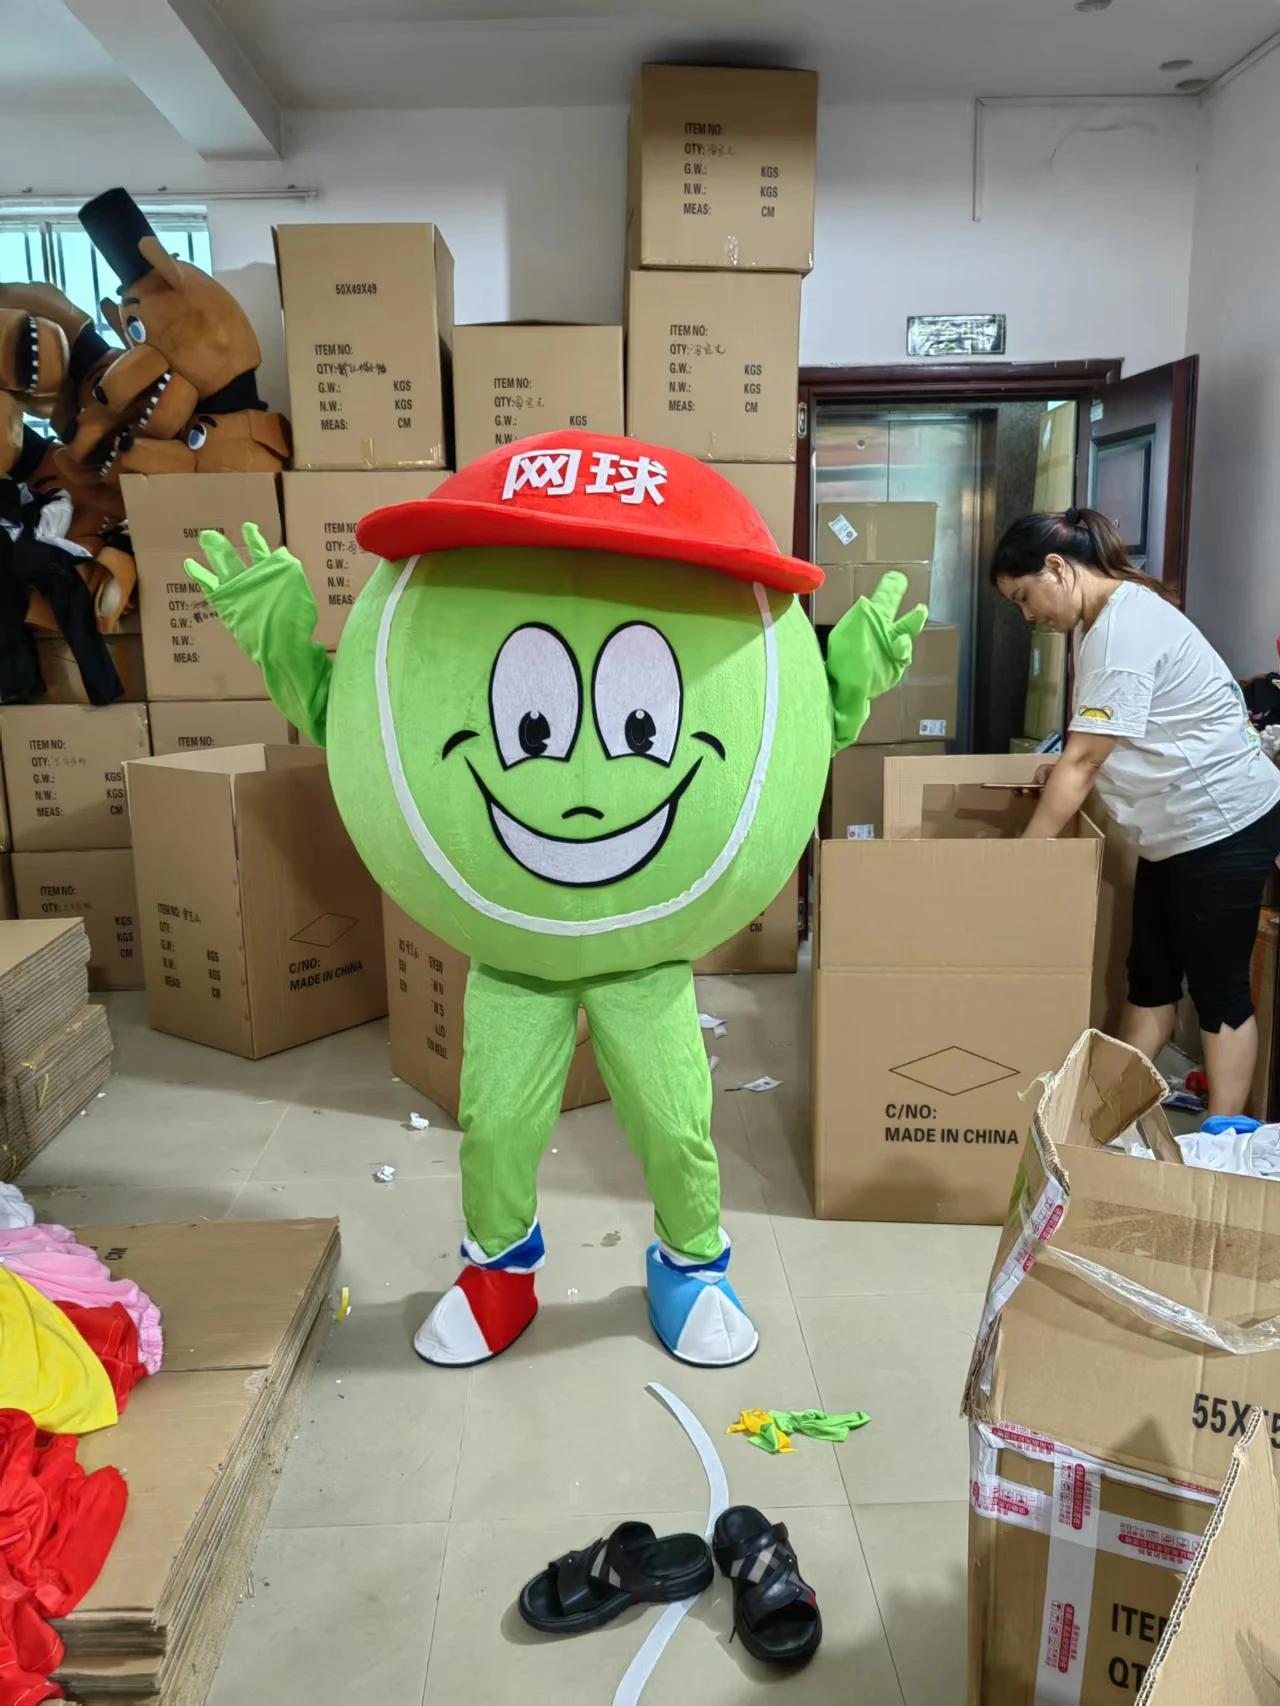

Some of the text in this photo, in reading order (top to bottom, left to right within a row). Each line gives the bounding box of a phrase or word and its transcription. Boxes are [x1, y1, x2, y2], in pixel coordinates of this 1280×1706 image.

[685, 122, 706, 135] ITEM
[684, 143, 705, 156] QTY:
[760, 166, 779, 178] KGS
[760, 186, 778, 198] KGS
[683, 203, 775, 217] MEAS: CM
[335, 283, 377, 295] 50X49X49
[670, 324, 708, 337] ITEM NO:
[315, 344, 354, 356] ITEM NO:
[670, 343, 690, 355] QTY:
[317, 364, 337, 375] QTY:
[669, 362, 762, 376] G.W.: KGS
[318, 380, 411, 393] G.W.: KGS
[494, 377, 532, 389] ITEM NO:
[669, 381, 761, 394] N.W.: KGS
[320, 399, 413, 412] N.W.: KGS
[494, 396, 515, 408] QTY:
[668, 400, 758, 413] MEAS: CM
[321, 417, 411, 430] MEAS: CM
[495, 415, 587, 426] G.W.: KGS
[502, 448, 668, 505] 网球
[324, 522, 345, 533] ITEM
[325, 540, 345, 552] QTY:
[326, 558, 349, 569] G.W.:
[167, 582, 187, 594] ITEM
[327, 577, 350, 587] N.W.:
[168, 601, 188, 611] QTY:
[173, 653, 200, 663] MEAS:
[29, 739, 66, 750] ITEM NO:
[178, 736, 215, 747] ITEM NO:
[31, 756, 51, 767] QTY:
[105, 771, 122, 782] KGS
[106, 788, 124, 799] KGS
[37, 805, 123, 817] MEAS: CM
[40, 885, 76, 897] ITEM NO:
[115, 916, 133, 926] KGS
[750, 922, 763, 933] CM
[117, 932, 134, 942] KGS
[120, 948, 133, 959] CM
[288, 957, 321, 975] C/NO:
[290, 959, 363, 992] MADE IN CHINA
[211, 987, 221, 999] CM
[885, 1104, 938, 1120] C/NO:
[884, 1127, 1019, 1145] MADE IN CHINA
[1192, 1392, 1280, 1450] 55X5
